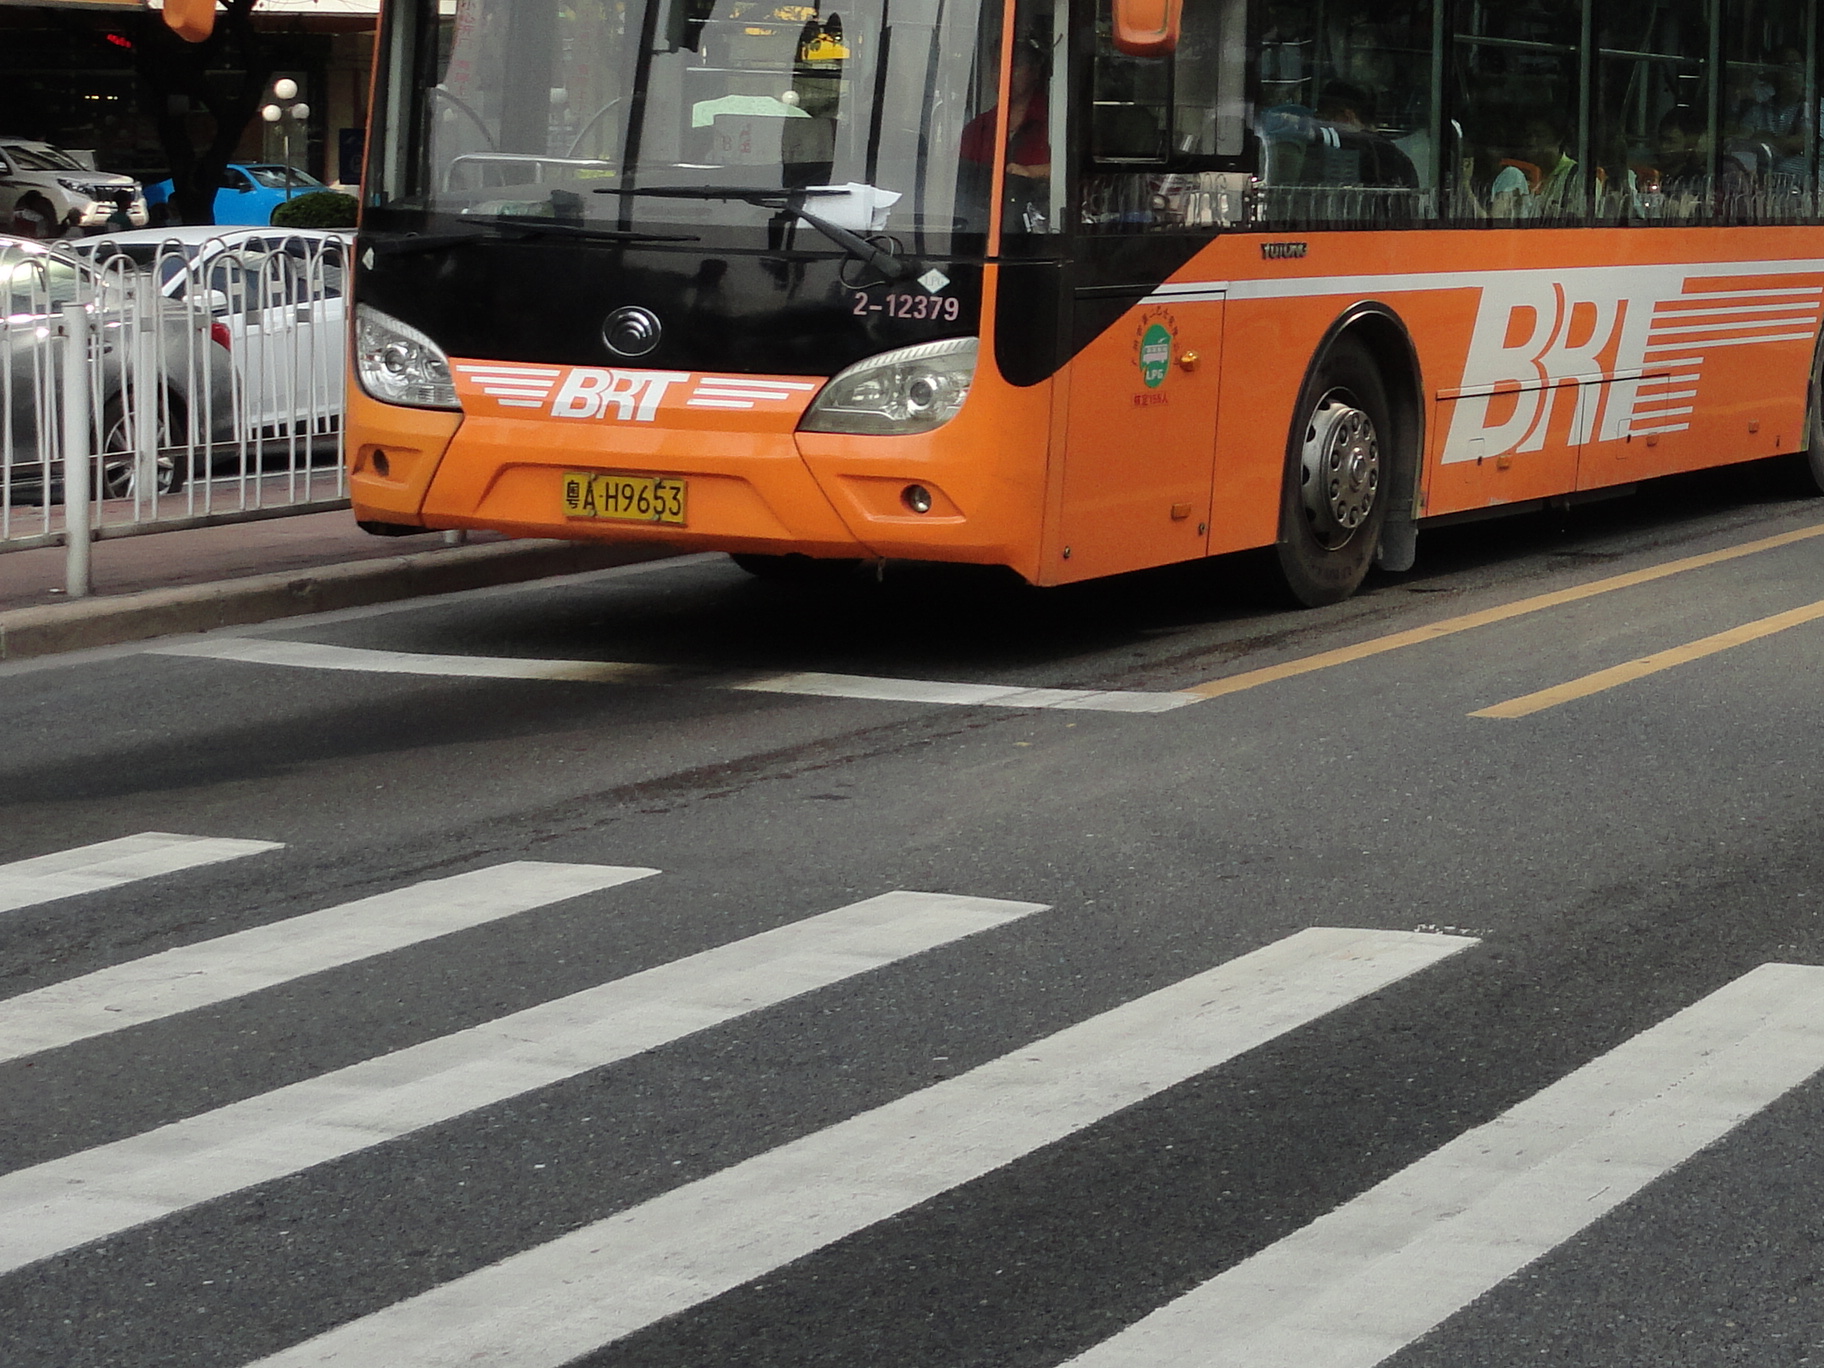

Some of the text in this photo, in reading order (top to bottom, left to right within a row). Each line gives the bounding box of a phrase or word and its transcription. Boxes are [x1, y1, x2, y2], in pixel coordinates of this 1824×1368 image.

[853, 291, 960, 322] 2-12379
[1145, 368, 1164, 380] LPG
[1441, 268, 1687, 465] BRT
[550, 367, 692, 423] BRT
